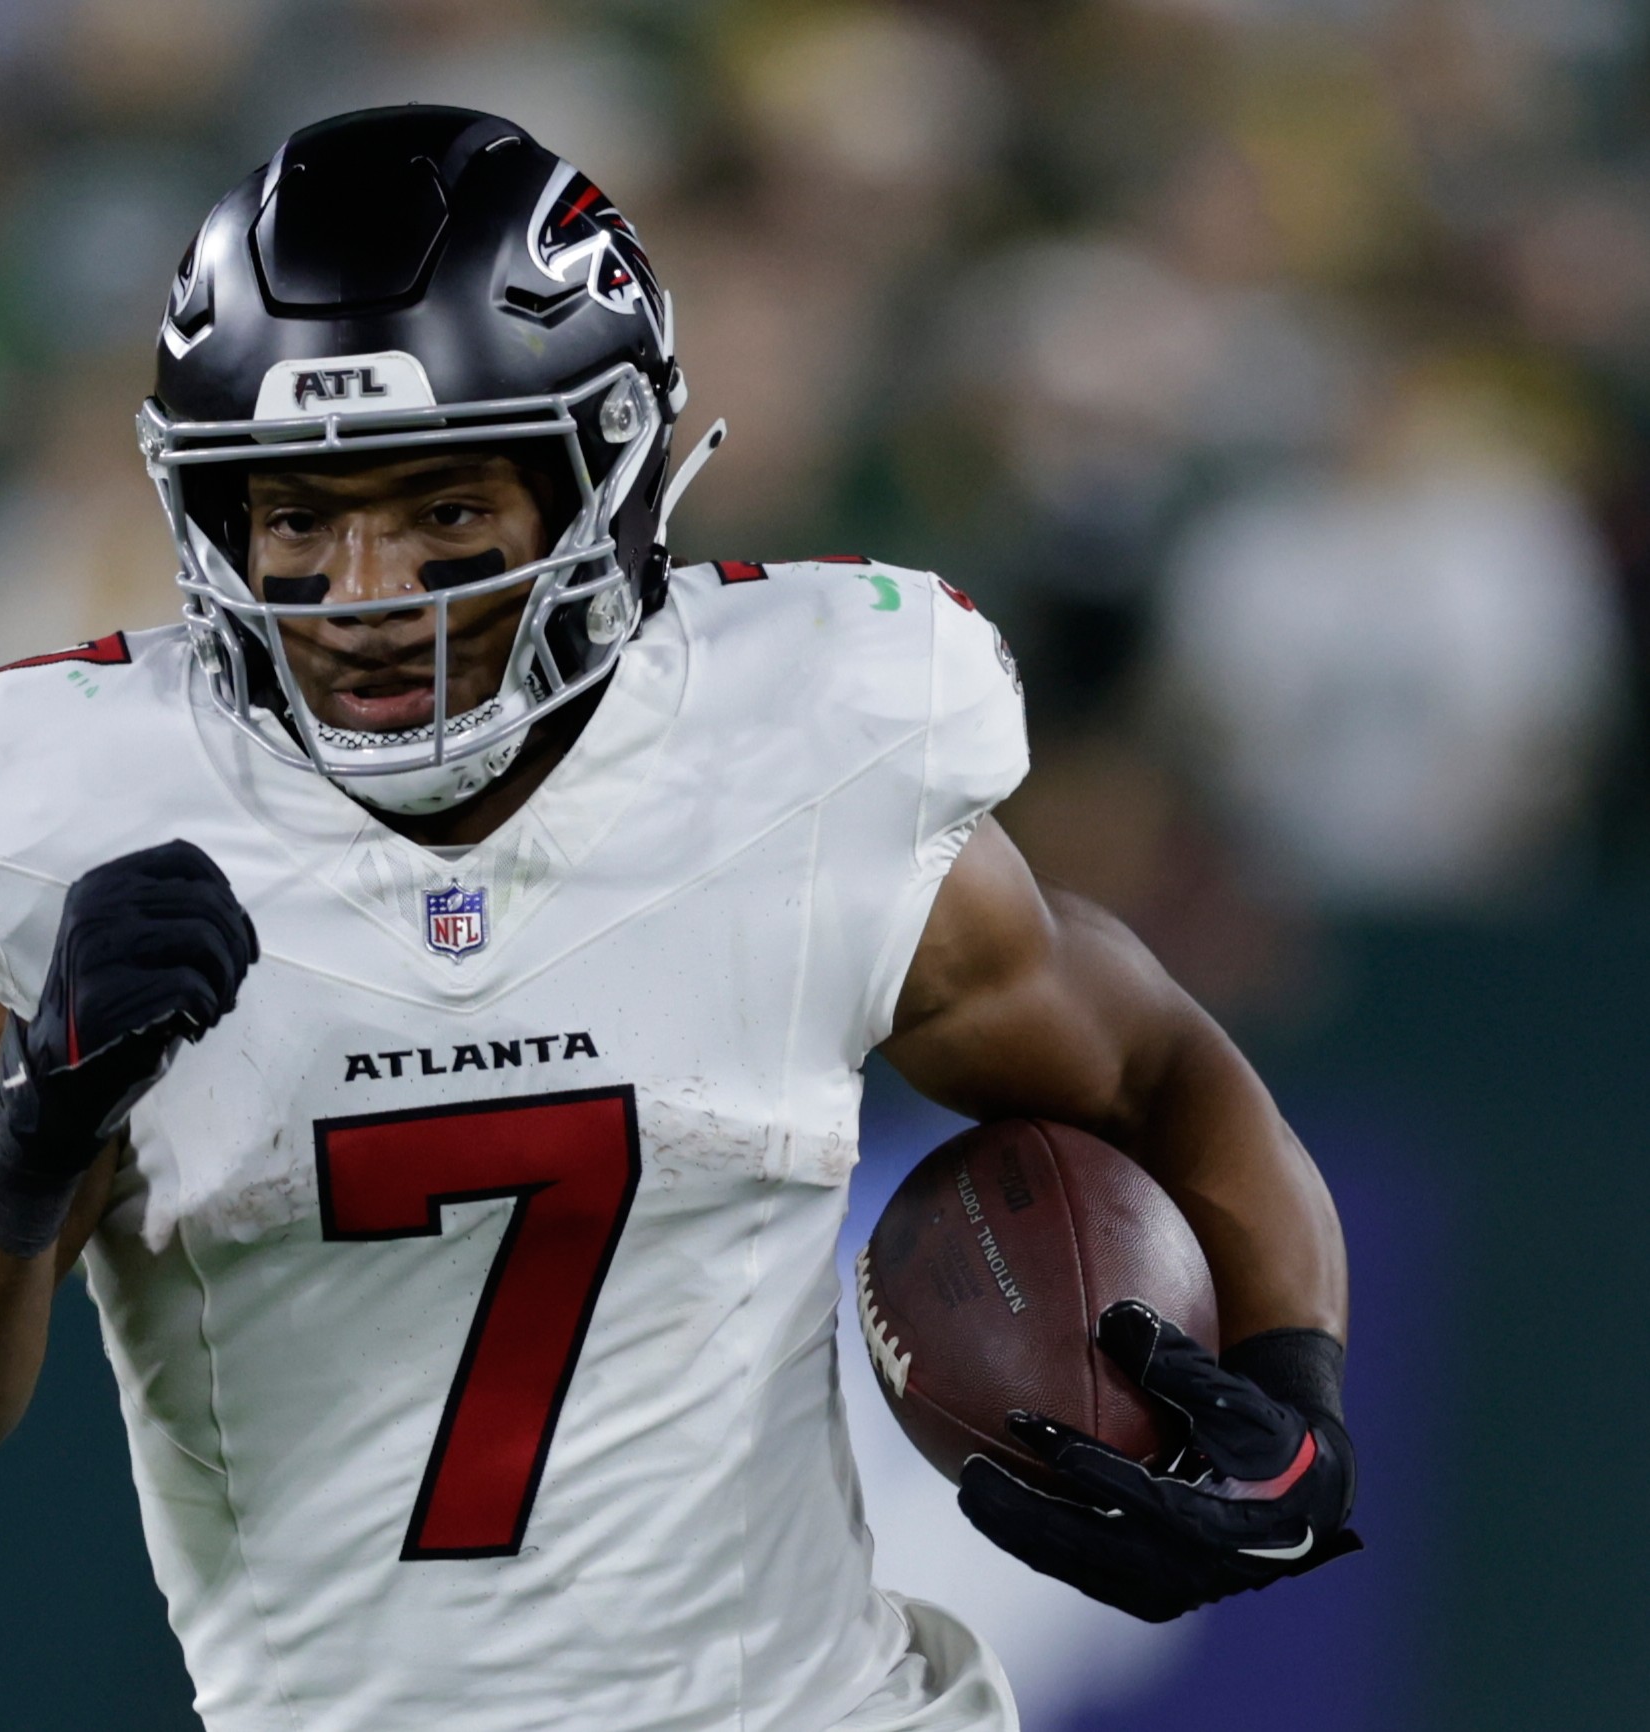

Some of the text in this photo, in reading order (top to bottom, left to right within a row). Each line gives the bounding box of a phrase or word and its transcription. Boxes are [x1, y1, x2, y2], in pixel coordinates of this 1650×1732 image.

[291, 366, 388, 411] ATL
[432, 915, 480, 949] NFL
[344, 1031, 600, 1082] ATLANTA
[977, 1225, 1027, 1315] NATIONAL
[312, 1083, 643, 1562] 7
